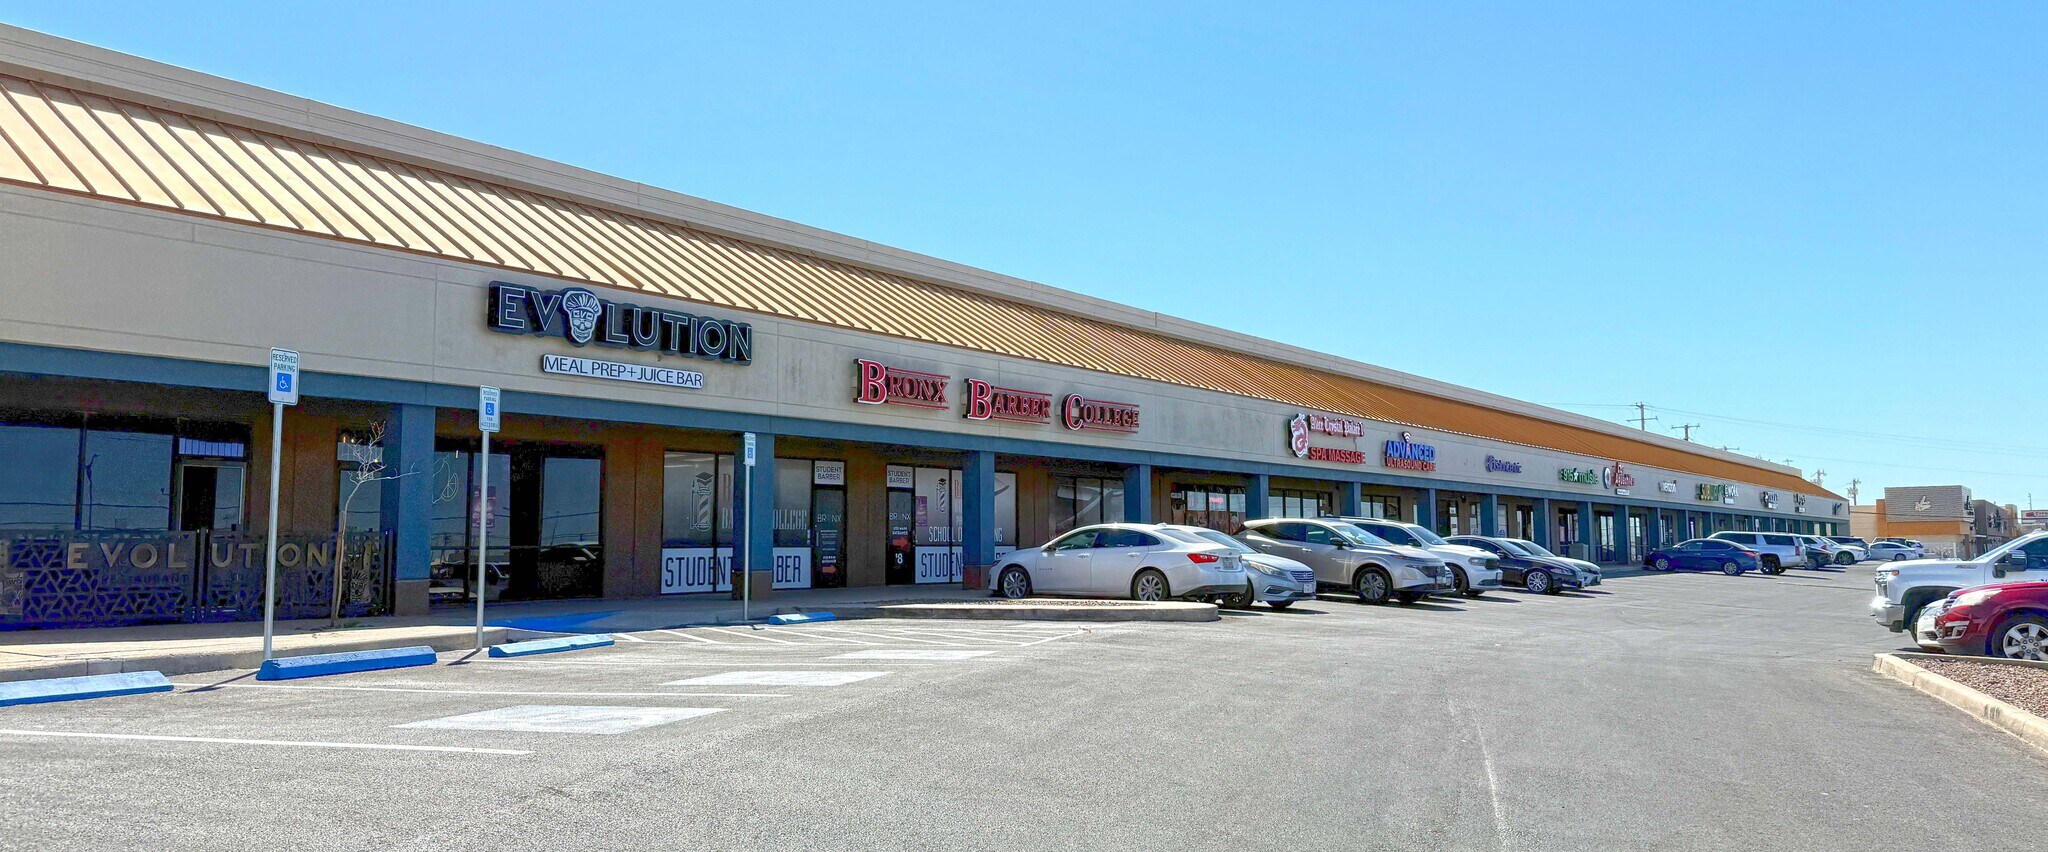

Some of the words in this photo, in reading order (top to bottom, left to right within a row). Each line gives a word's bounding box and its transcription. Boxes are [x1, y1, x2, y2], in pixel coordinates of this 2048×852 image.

[273, 362, 296, 372] PARKING
[544, 356, 588, 375] MEAL
[637, 367, 674, 384] JUICE
[676, 373, 703, 387] BAR
[1310, 447, 1327, 460] SPA
[1328, 449, 1366, 464] MASSAGE
[1386, 440, 1436, 461] ADVANCED
[1386, 457, 1422, 470] ULTRASOUND
[773, 509, 807, 530] OLLEGE
[67, 542, 328, 569] EVOLUTON
[921, 553, 963, 578] STUDEN
